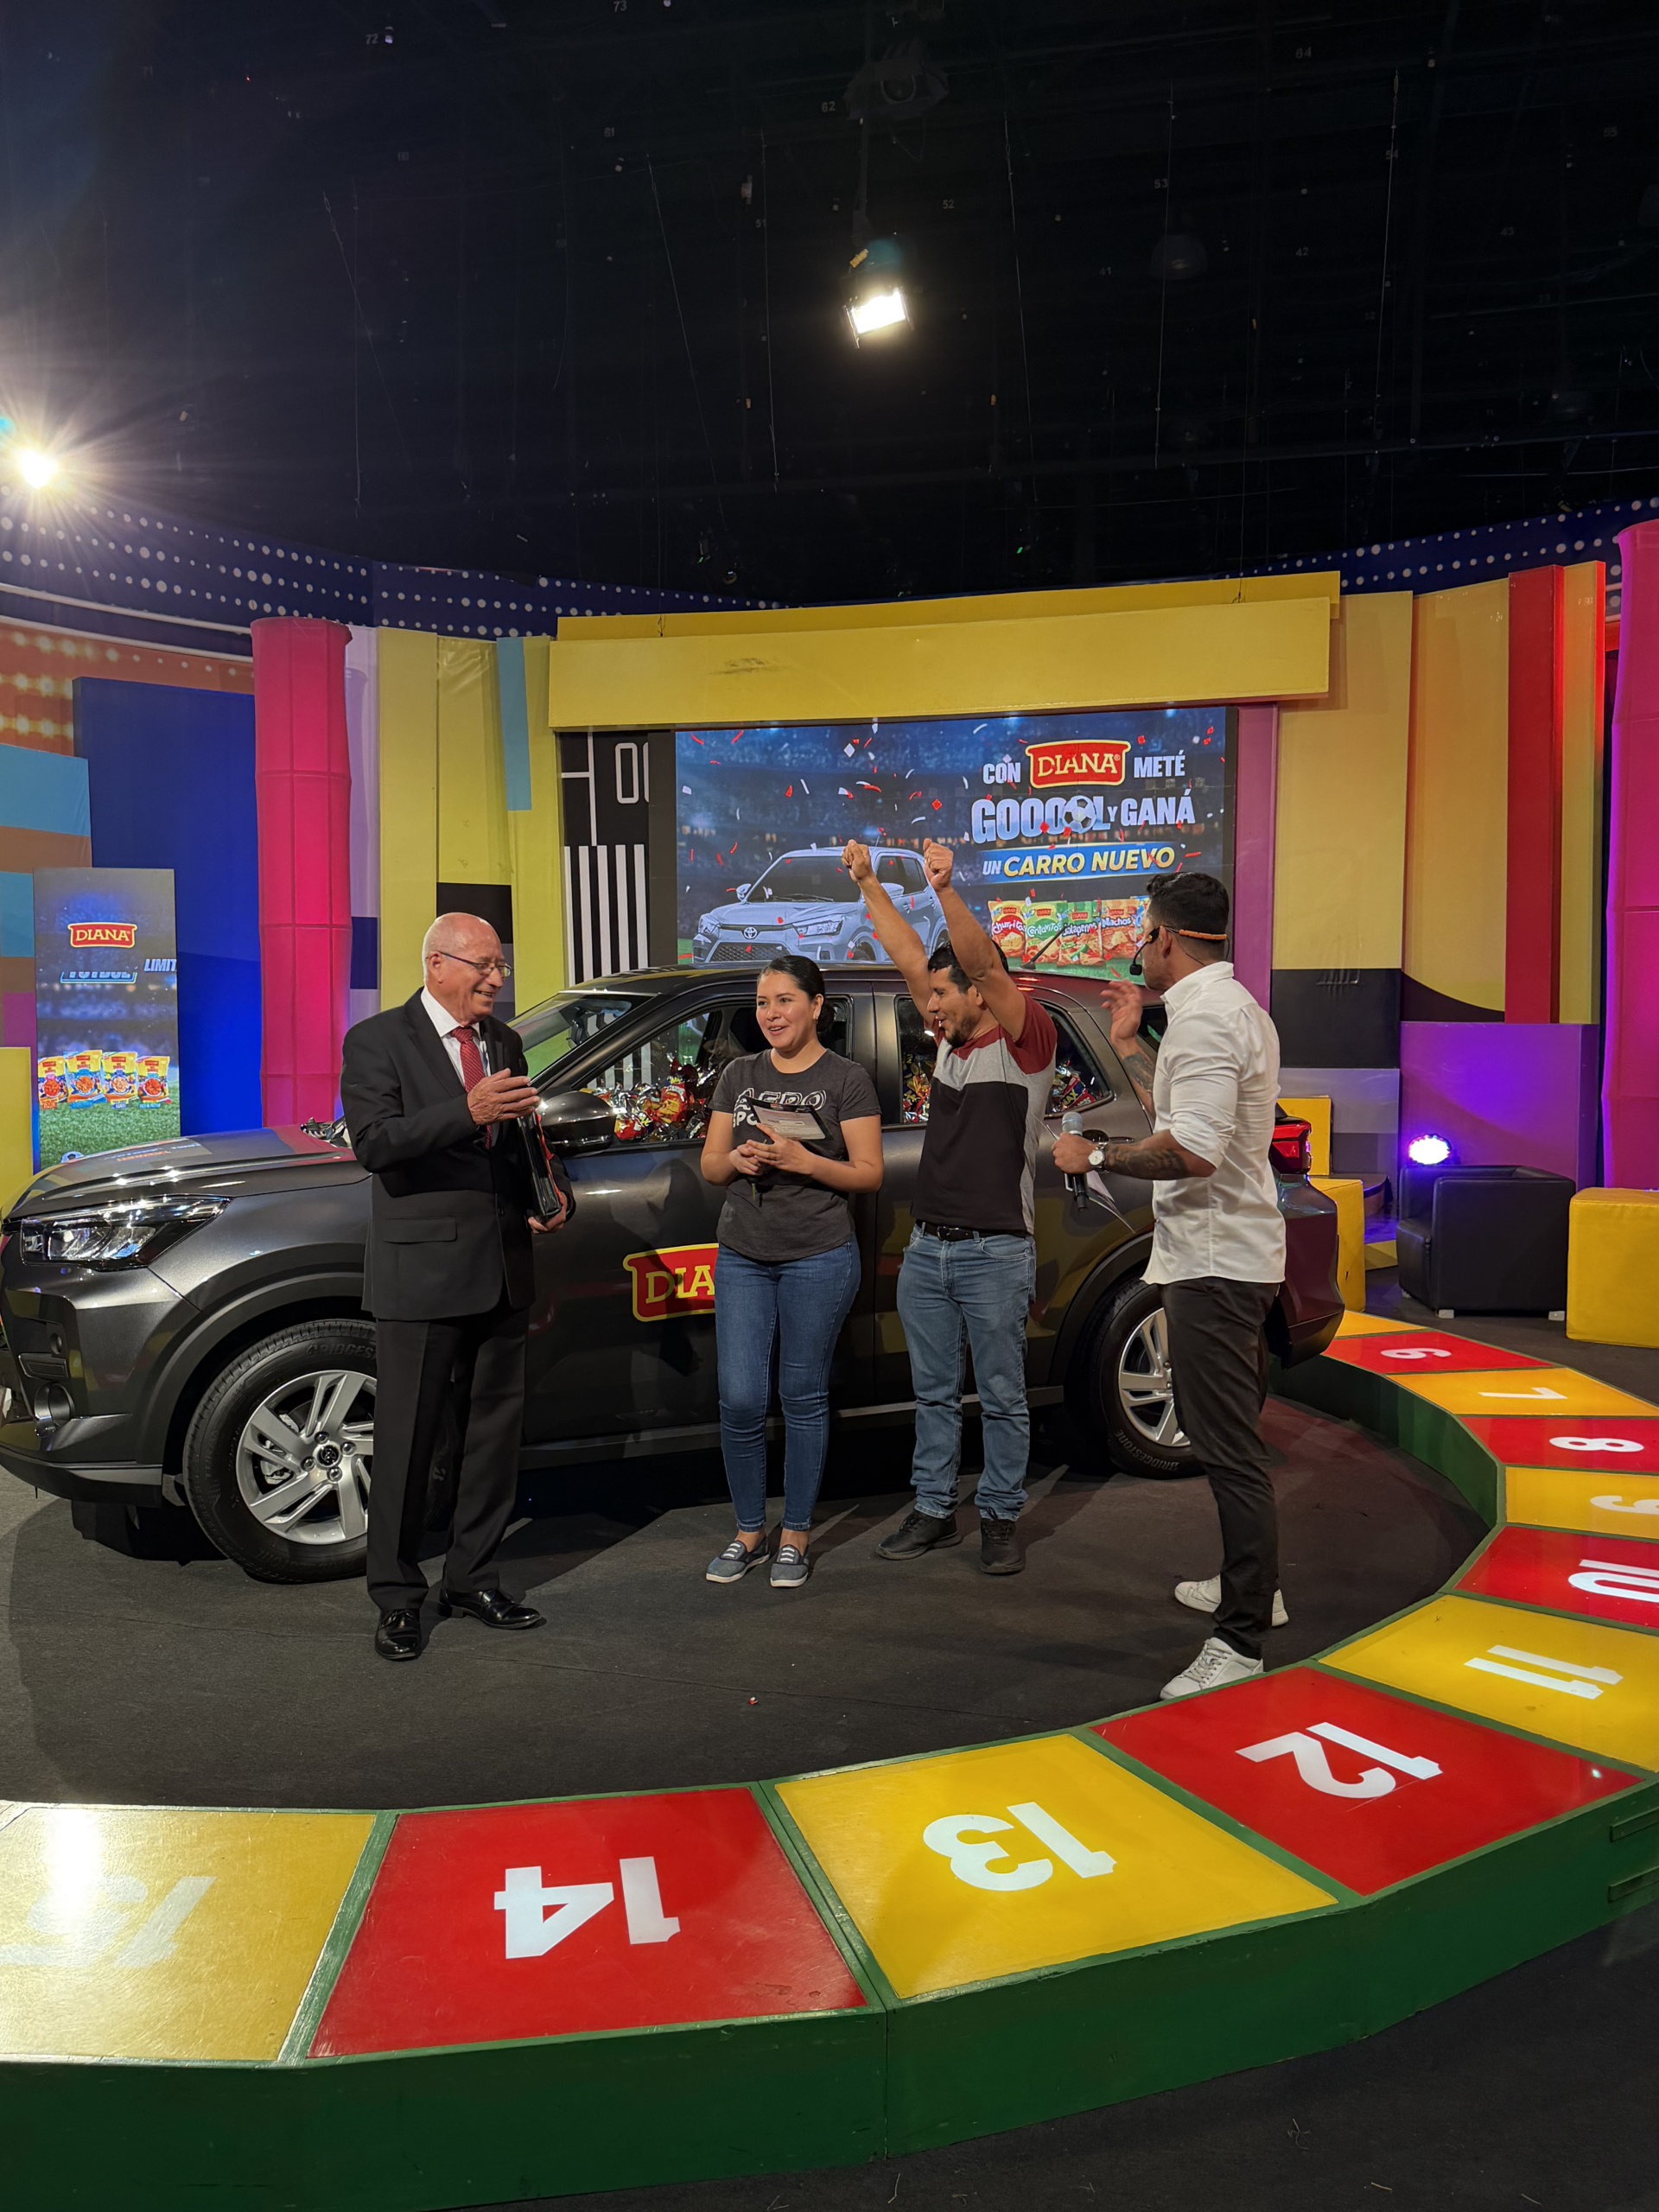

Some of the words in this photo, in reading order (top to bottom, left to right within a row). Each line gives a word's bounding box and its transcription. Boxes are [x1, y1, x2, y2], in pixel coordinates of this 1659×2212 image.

[613, 0, 627, 12] 73
[365, 33, 378, 45] 72
[822, 101, 836, 113] 62
[1154, 178, 1168, 189] 53
[942, 199, 955, 209] 52
[1500, 226, 1515, 236] 43
[1295, 246, 1309, 257] 42
[982, 762, 1021, 785] CON
[1134, 750, 1185, 779] METÉ
[1108, 805, 1119, 823] Y
[1121, 788, 1196, 827] GANÁ
[982, 860, 1001, 875] UN
[1003, 853, 1085, 877] CARRO
[1091, 847, 1175, 872] NUEVO
[645, 1264, 715, 1304] DIA
[1380, 1347, 1452, 1360] 6
[1478, 1387, 1568, 1400] 7
[1115, 1429, 1180, 1472] BRIDGESTONE
[1548, 1436, 1644, 1452] 8
[1464, 1644, 1624, 1700] 11
[1235, 1721, 1443, 1799] 12
[923, 1801, 1117, 1892] 13
[493, 1855, 681, 1960] 14
